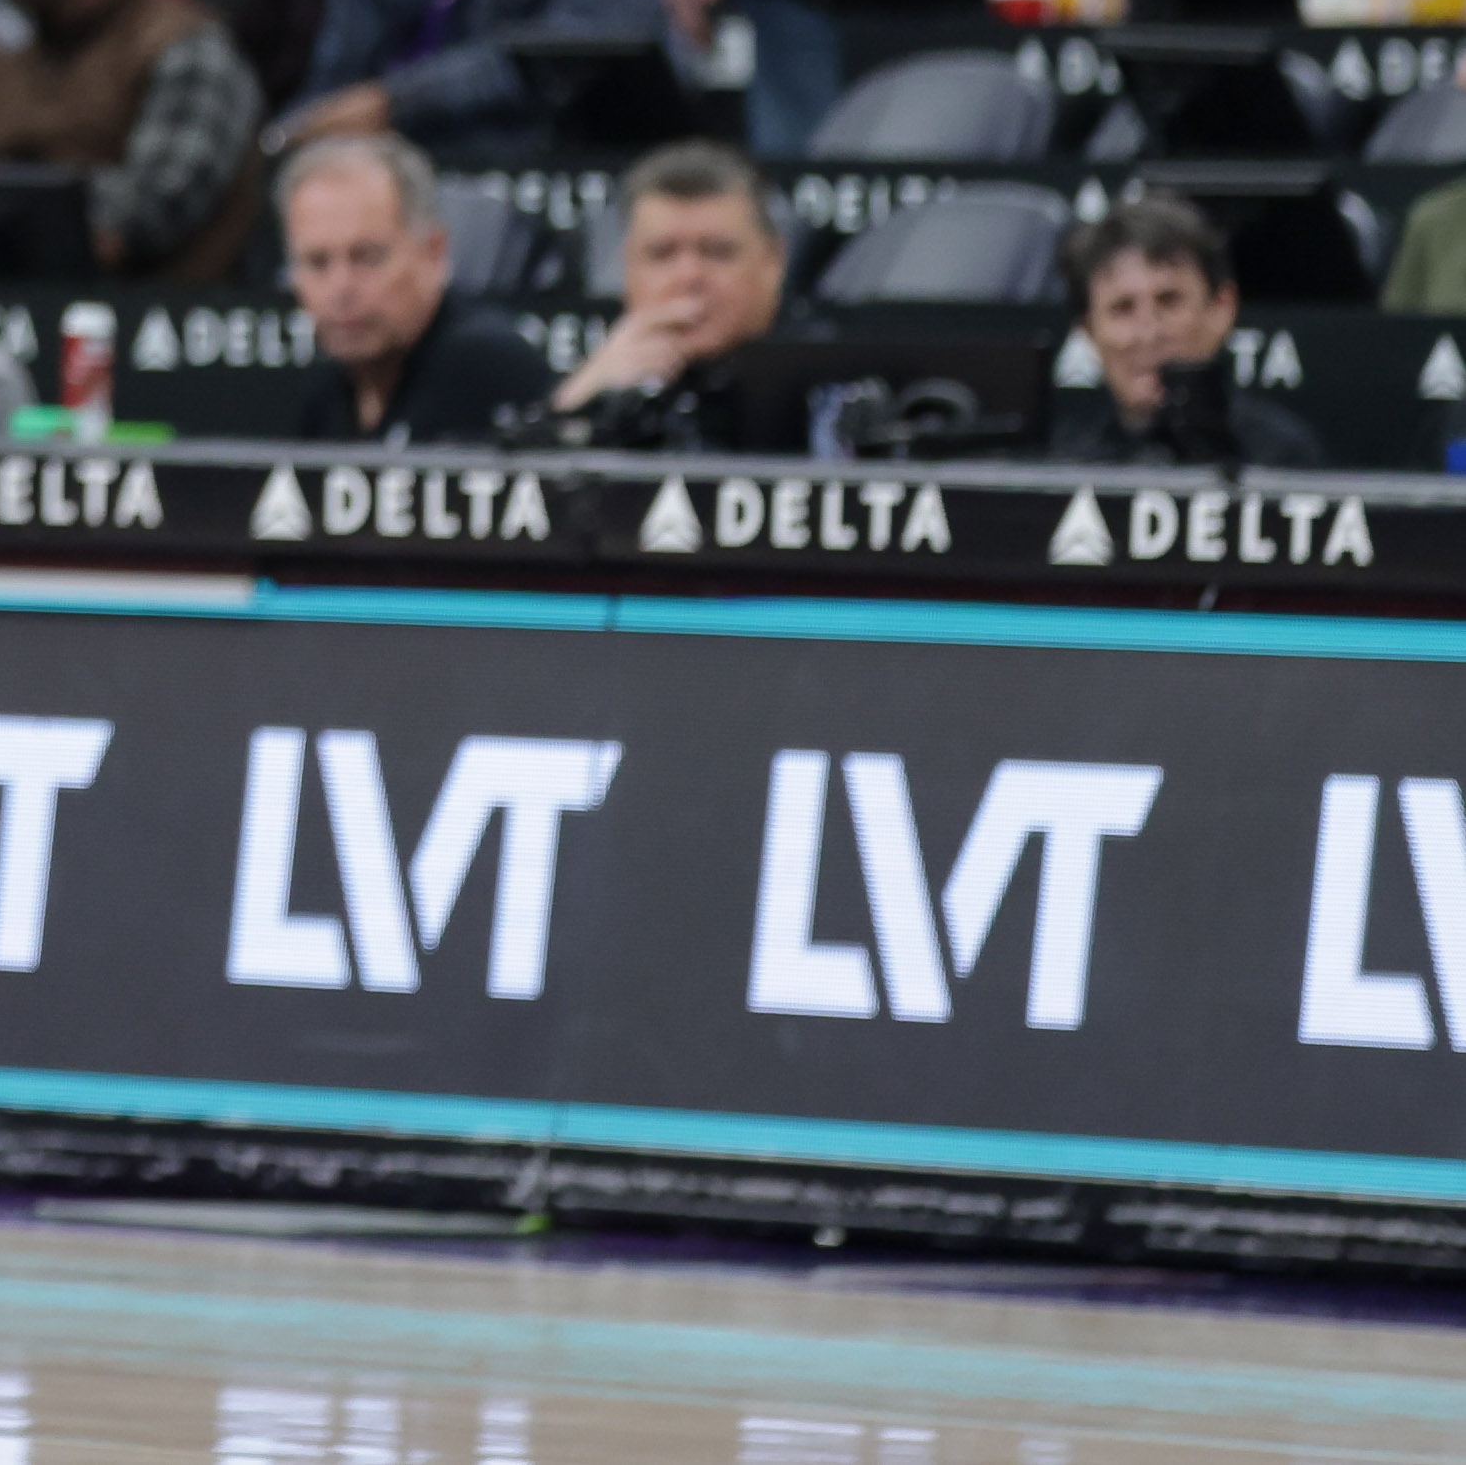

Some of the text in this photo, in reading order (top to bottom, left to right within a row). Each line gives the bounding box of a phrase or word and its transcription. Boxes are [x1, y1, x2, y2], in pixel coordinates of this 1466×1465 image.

[324, 465, 550, 540] DELTA
[716, 477, 952, 552] DELTA
[1129, 489, 1374, 567] DELTA
[225, 725, 623, 999] LVT
[746, 748, 1163, 1030] LVT
